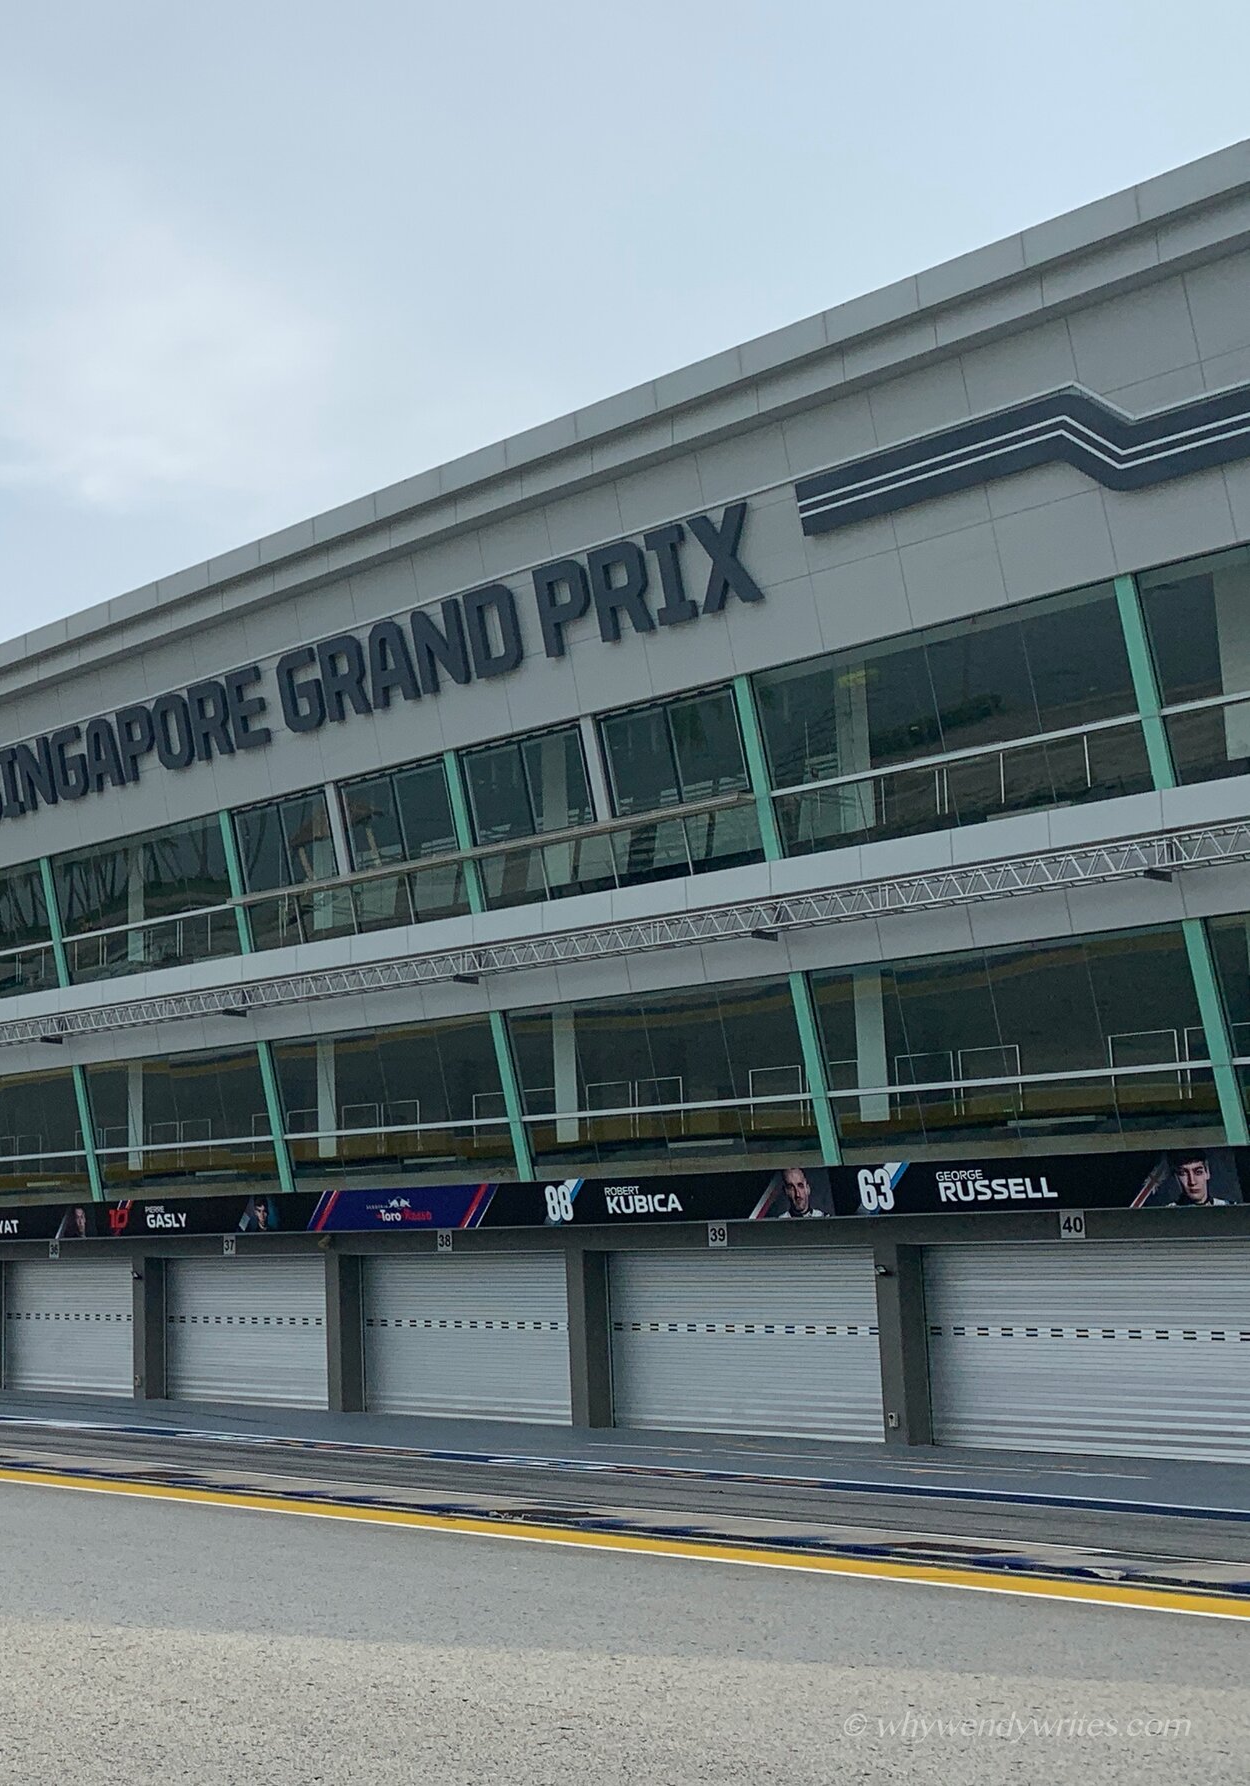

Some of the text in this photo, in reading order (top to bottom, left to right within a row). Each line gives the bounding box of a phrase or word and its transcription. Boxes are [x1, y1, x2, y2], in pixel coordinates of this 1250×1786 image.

[276, 583, 524, 734] GRAND
[532, 501, 765, 659] PRIX
[935, 1169, 984, 1182] GEORGE
[604, 1185, 640, 1197] ROBERT
[858, 1168, 895, 1211] 63
[937, 1176, 1059, 1202] RUSSELL
[144, 1205, 165, 1213] PIERRE
[544, 1184, 575, 1221] 88
[605, 1192, 684, 1214] KUBICA
[109, 1208, 129, 1230] 10
[146, 1212, 187, 1228] GASLY
[380, 1209, 402, 1221] Toro
[1062, 1215, 1084, 1233] 40
[438, 1234, 451, 1248] 38
[709, 1227, 726, 1242] 39
[224, 1239, 235, 1251] 37
